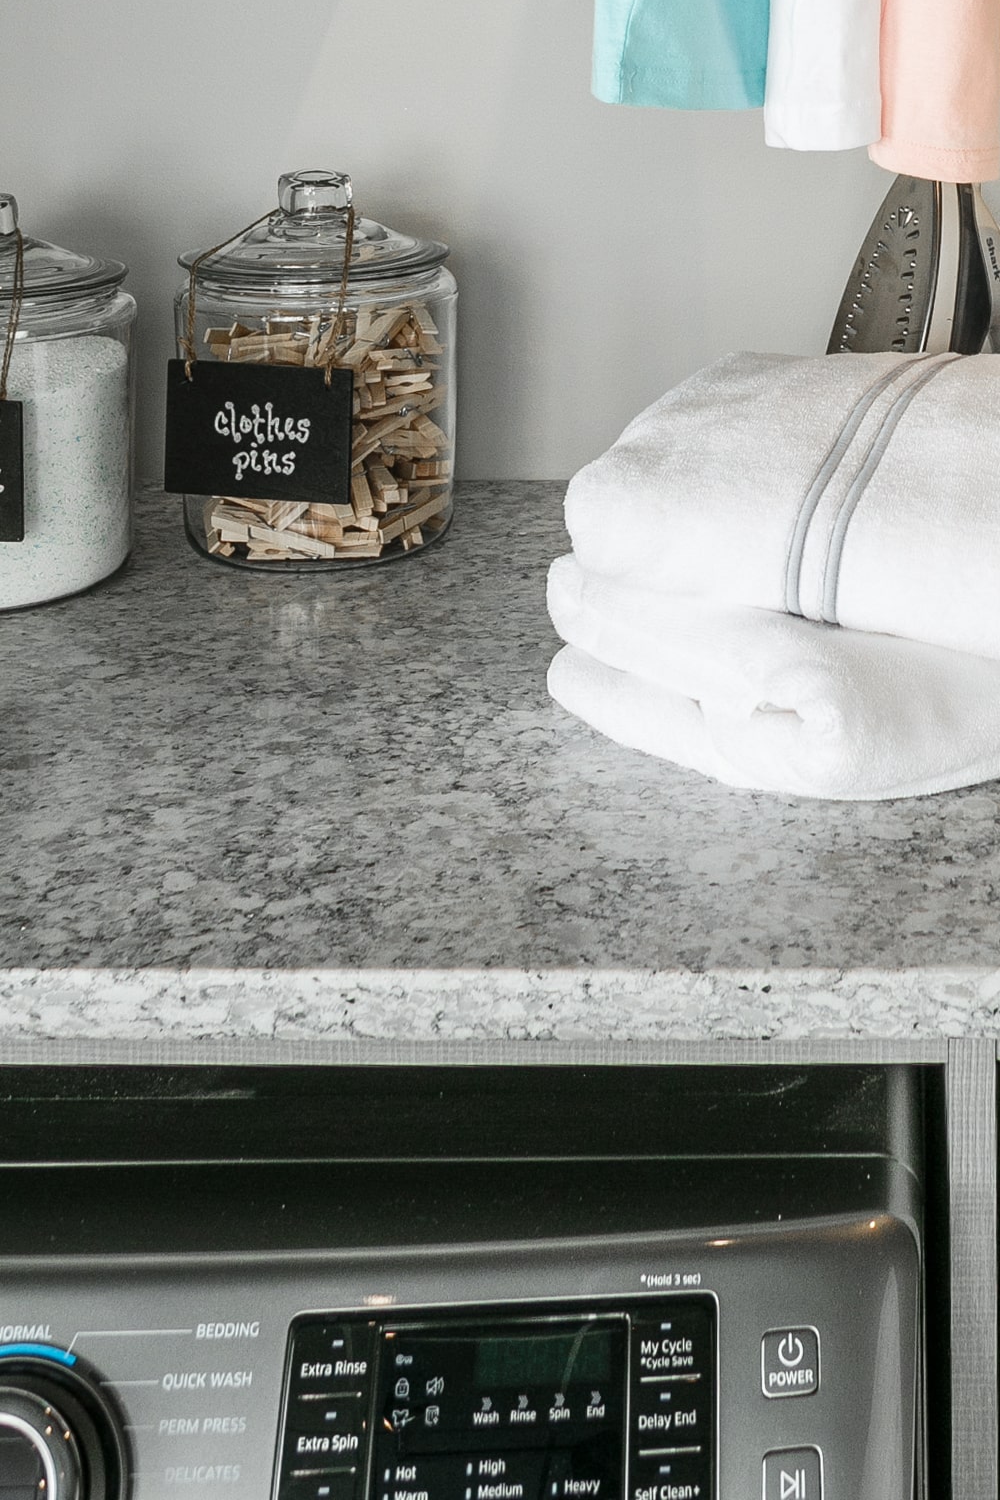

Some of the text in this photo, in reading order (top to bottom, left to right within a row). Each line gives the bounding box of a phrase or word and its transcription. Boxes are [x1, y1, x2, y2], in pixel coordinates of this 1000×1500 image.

[986, 237, 1000, 282] Shark
[214, 401, 311, 444] clothes
[232, 442, 296, 480] pins
[674, 1273, 681, 1286] 3
[682, 1272, 702, 1286] sec)
[196, 1321, 260, 1340] BEDDING
[641, 1338, 693, 1357] My Cycle
[301, 1359, 367, 1378] Extra Rinse
[671, 1356, 694, 1367] Save
[162, 1371, 253, 1391] QUICK WASH
[769, 1368, 814, 1387] POWER
[473, 1411, 500, 1425] Wash
[510, 1409, 537, 1423] Rinse
[549, 1407, 571, 1422] Spin
[586, 1404, 605, 1418] End
[638, 1409, 697, 1430] Delay End
[159, 1416, 247, 1436] PERM PRESS
[297, 1433, 358, 1453] Extra Spin
[164, 1465, 241, 1482] DELICATES
[395, 1465, 417, 1481] Hot
[478, 1458, 506, 1477] High
[477, 1483, 523, 1500] Medium
[564, 1479, 601, 1496] Heavy
[635, 1484, 692, 1500] Self Clean
